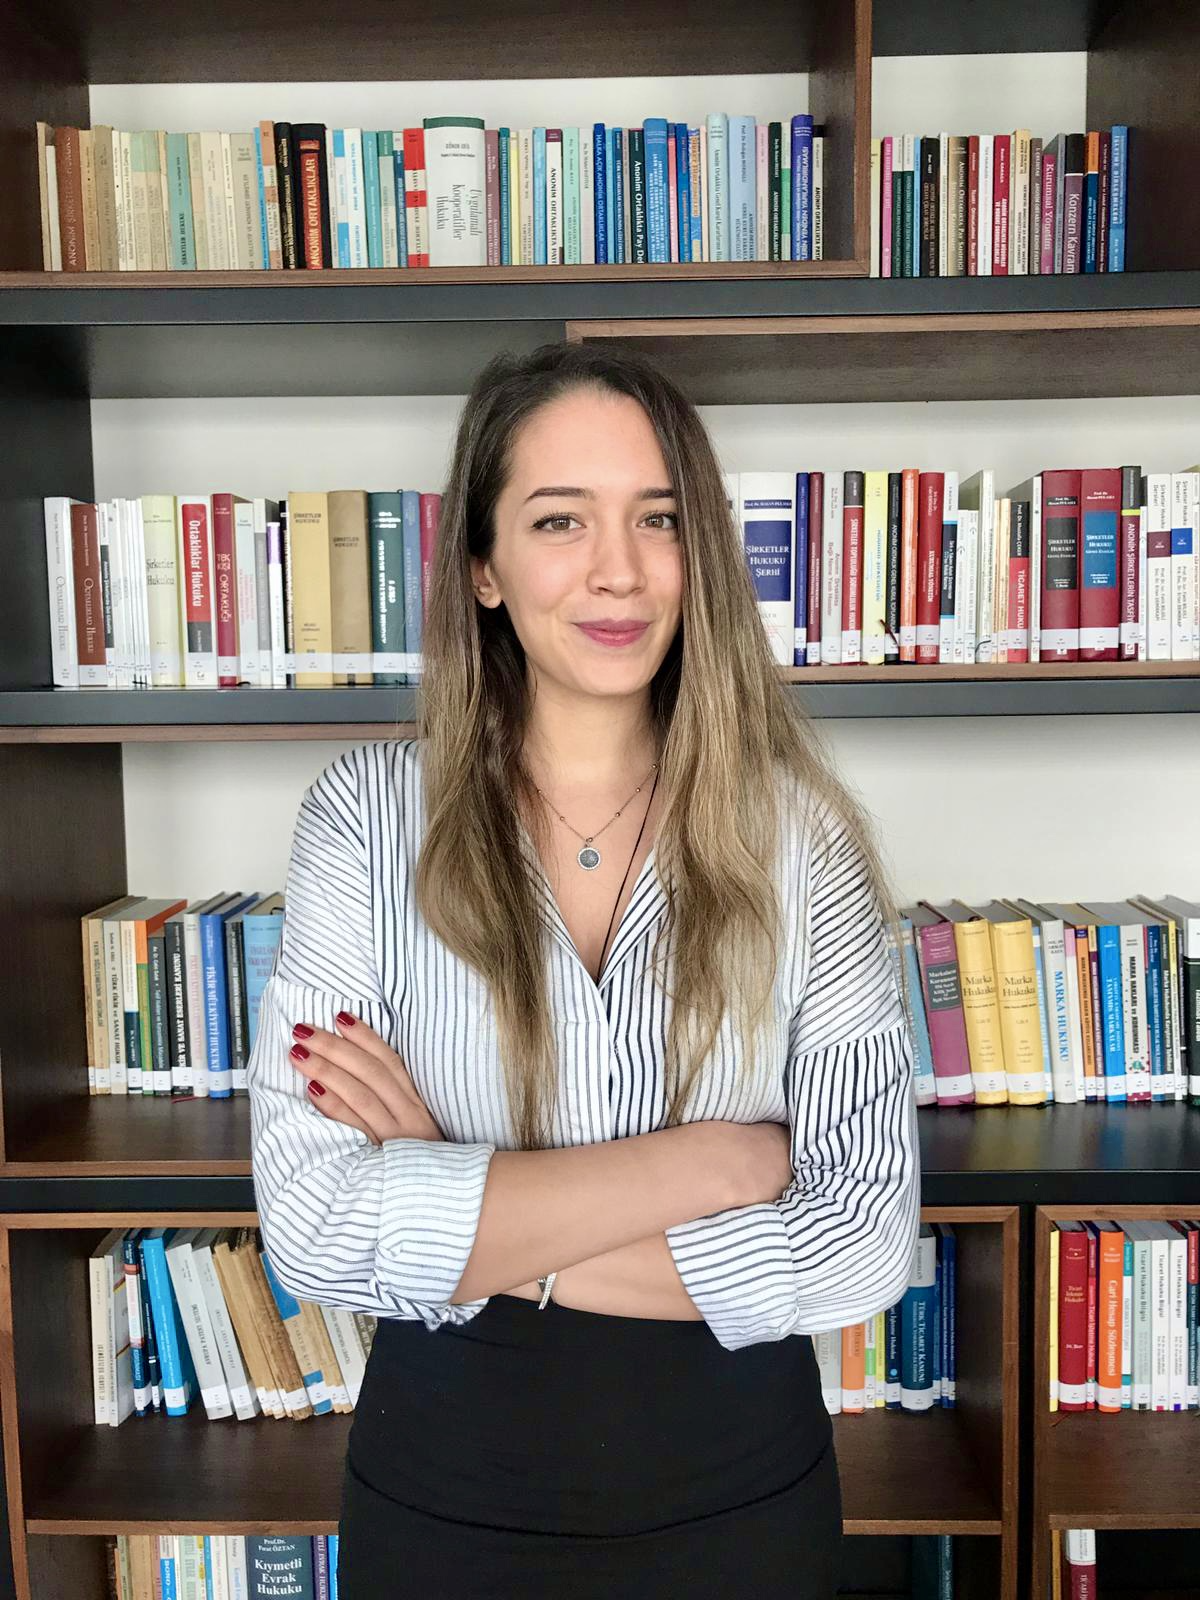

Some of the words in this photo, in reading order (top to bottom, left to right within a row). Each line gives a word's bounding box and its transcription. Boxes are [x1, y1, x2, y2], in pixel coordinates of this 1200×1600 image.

[634, 160, 642, 192] Anonim
[1046, 162, 1054, 209] Kurumsal
[305, 159, 317, 226] ORTAKLIKLAR
[636, 193, 644, 232] Ortaklıkta
[1068, 193, 1080, 235] Konzern
[635, 234, 645, 248] Pay
[1044, 210, 1054, 250] Yönetim
[306, 228, 320, 266] ANONİM
[189, 520, 202, 570] Ortaklıklar
[850, 518, 858, 546] ŞİRKETLER
[890, 524, 898, 546] ANONİM
[1086, 534, 1114, 542] ŞİRKETLER
[1128, 523, 1136, 552] ANONİM
[746, 544, 790, 554] ŞİRKETLER
[750, 556, 786, 566] HUKUKU
[756, 568, 780, 578] ŞERHİ
[1126, 553, 1136, 592] ŞİRKETLERİN
[191, 571, 204, 606] Hukuku
[1017, 570, 1026, 604] TİCARET
[174, 953, 182, 982] KANUNU
[206, 966, 218, 988] FİKİR
[965, 976, 992, 986] Marka
[1004, 976, 1033, 986] Marka
[1054, 959, 1065, 1002] MARKA
[1129, 956, 1137, 979] MARKA
[111, 974, 119, 990] TÜRK
[1002, 986, 1036, 998] Hukuku
[1130, 980, 1138, 1007] HAKLARI
[112, 992, 120, 1008] FİKİR
[175, 983, 184, 1019] ESERLERİ
[208, 990, 220, 1036] MÜLKİYETİ
[176, 1019, 185, 1042] SANAT
[1057, 1004, 1069, 1052] HUKUKU
[1131, 1016, 1140, 1054] KORUNMASI
[176, 1044, 186, 1054] VE
[210, 1036, 220, 1070] HUKUKU
[1108, 1280, 1118, 1299] Cari
[918, 1301, 926, 1321] TÜRK
[1106, 1300, 1117, 1327] Hesap
[918, 1323, 926, 1352] TİCARET
[133, 1348, 142, 1381] KORUNMASI
[1106, 1329, 1118, 1376] Sözleşmesi
[918, 1353, 926, 1383] KANUNU
[254, 1558, 302, 1573] Kıymetli
[262, 1572, 296, 1584] Evrak
[257, 1584, 302, 1596] Hukuku
